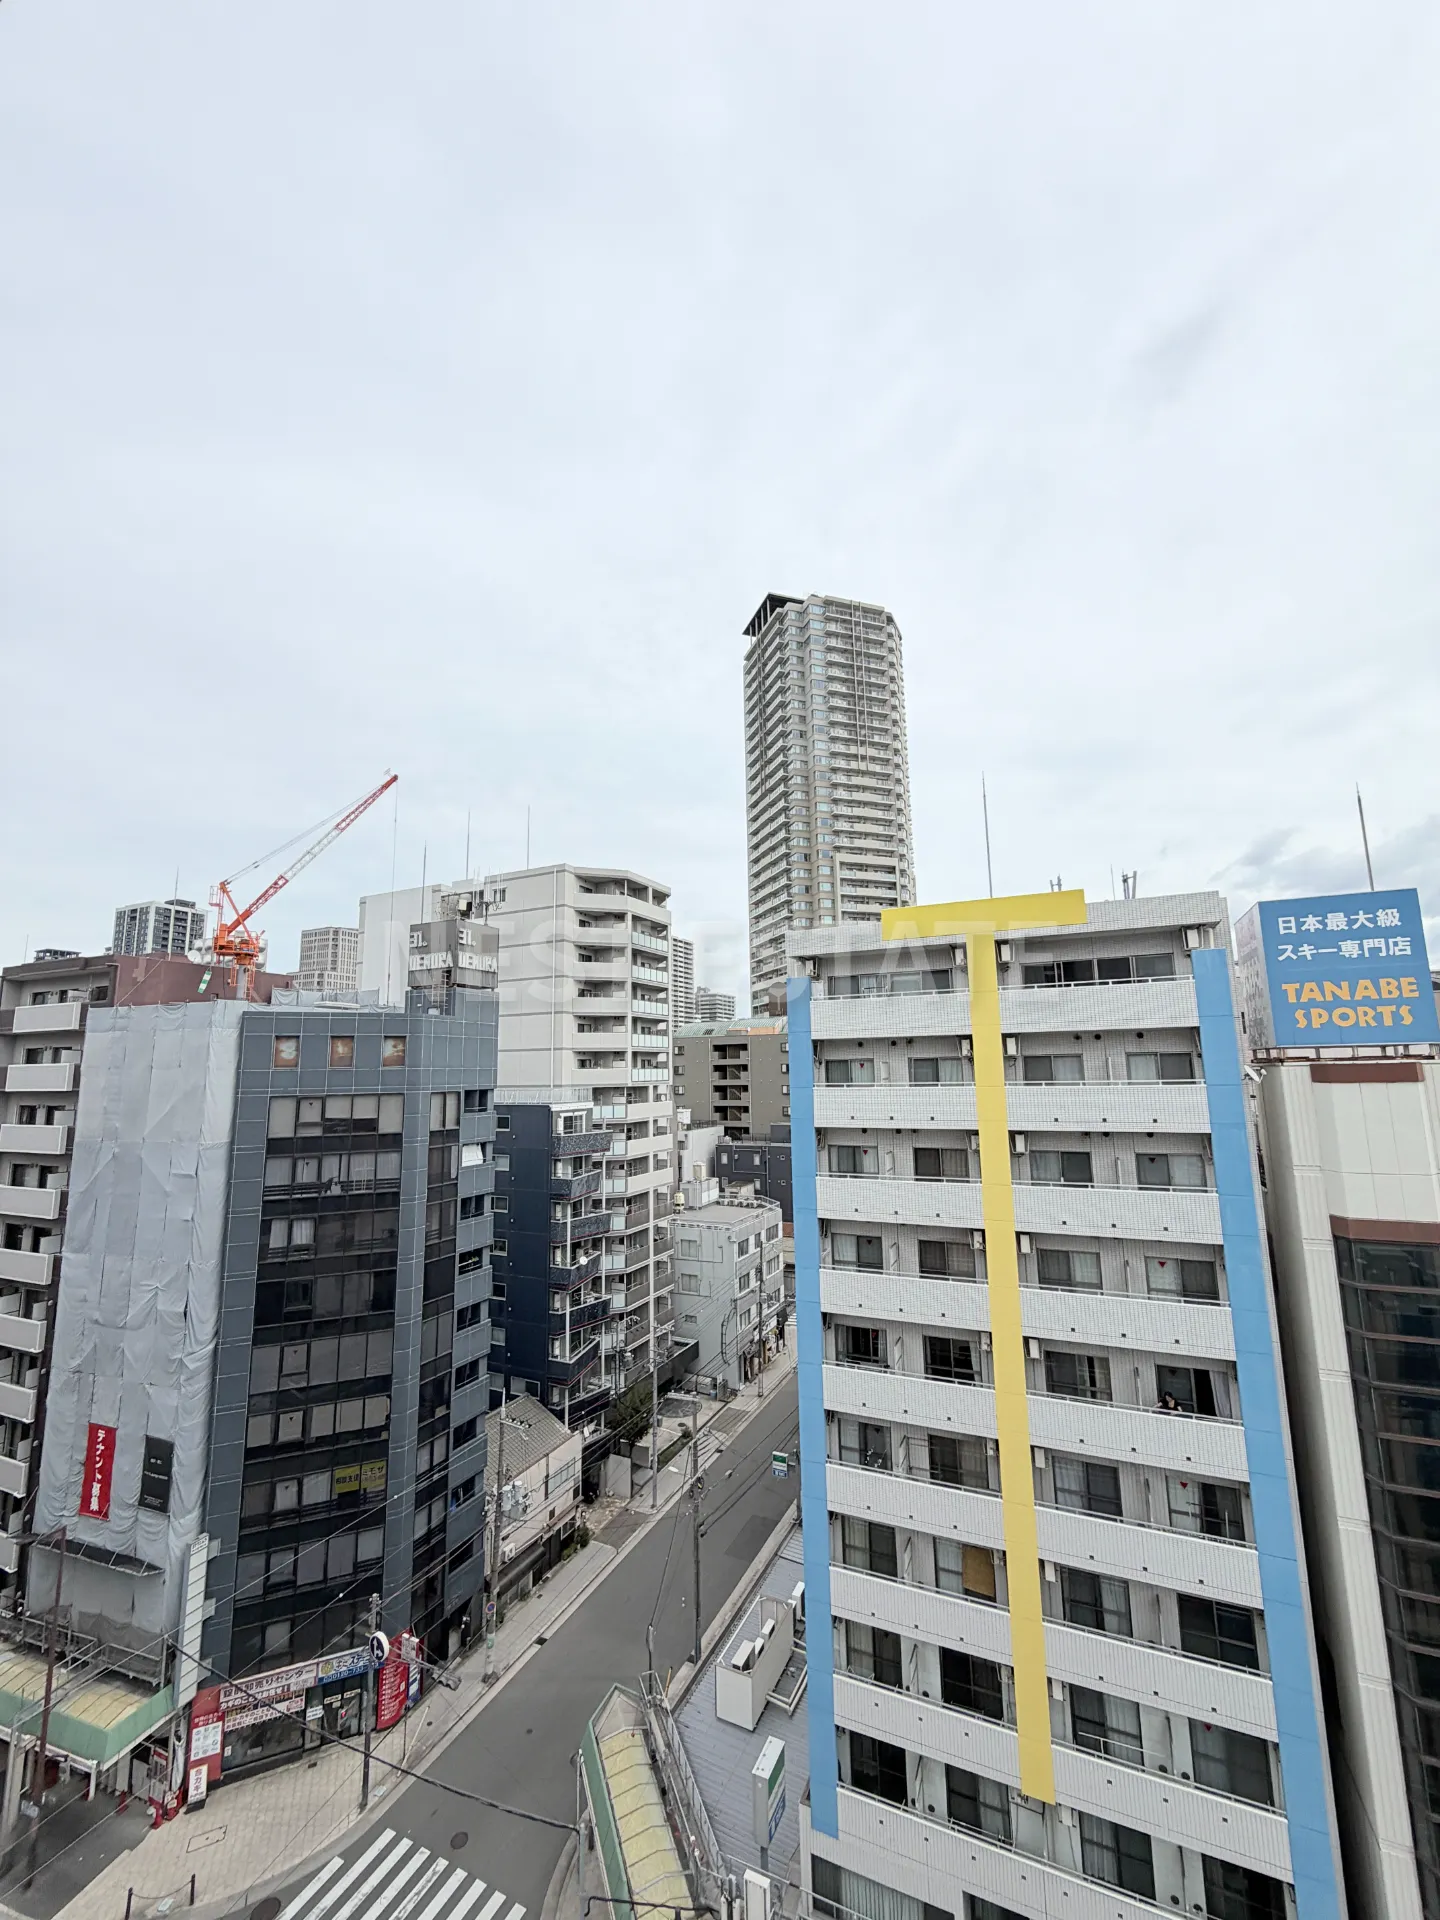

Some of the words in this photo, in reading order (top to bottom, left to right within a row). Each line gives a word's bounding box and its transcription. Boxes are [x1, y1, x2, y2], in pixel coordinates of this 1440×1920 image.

[1278, 908, 1402, 935] 日本最大級
[409, 951, 454, 971] UEMURA
[1277, 937, 1411, 961] スキー専門店
[458, 951, 498, 972] UEMURA
[1282, 977, 1420, 1003] TANABE
[1294, 1005, 1414, 1029] SPORTS
[90, 1428, 106, 1511] テナント募集
